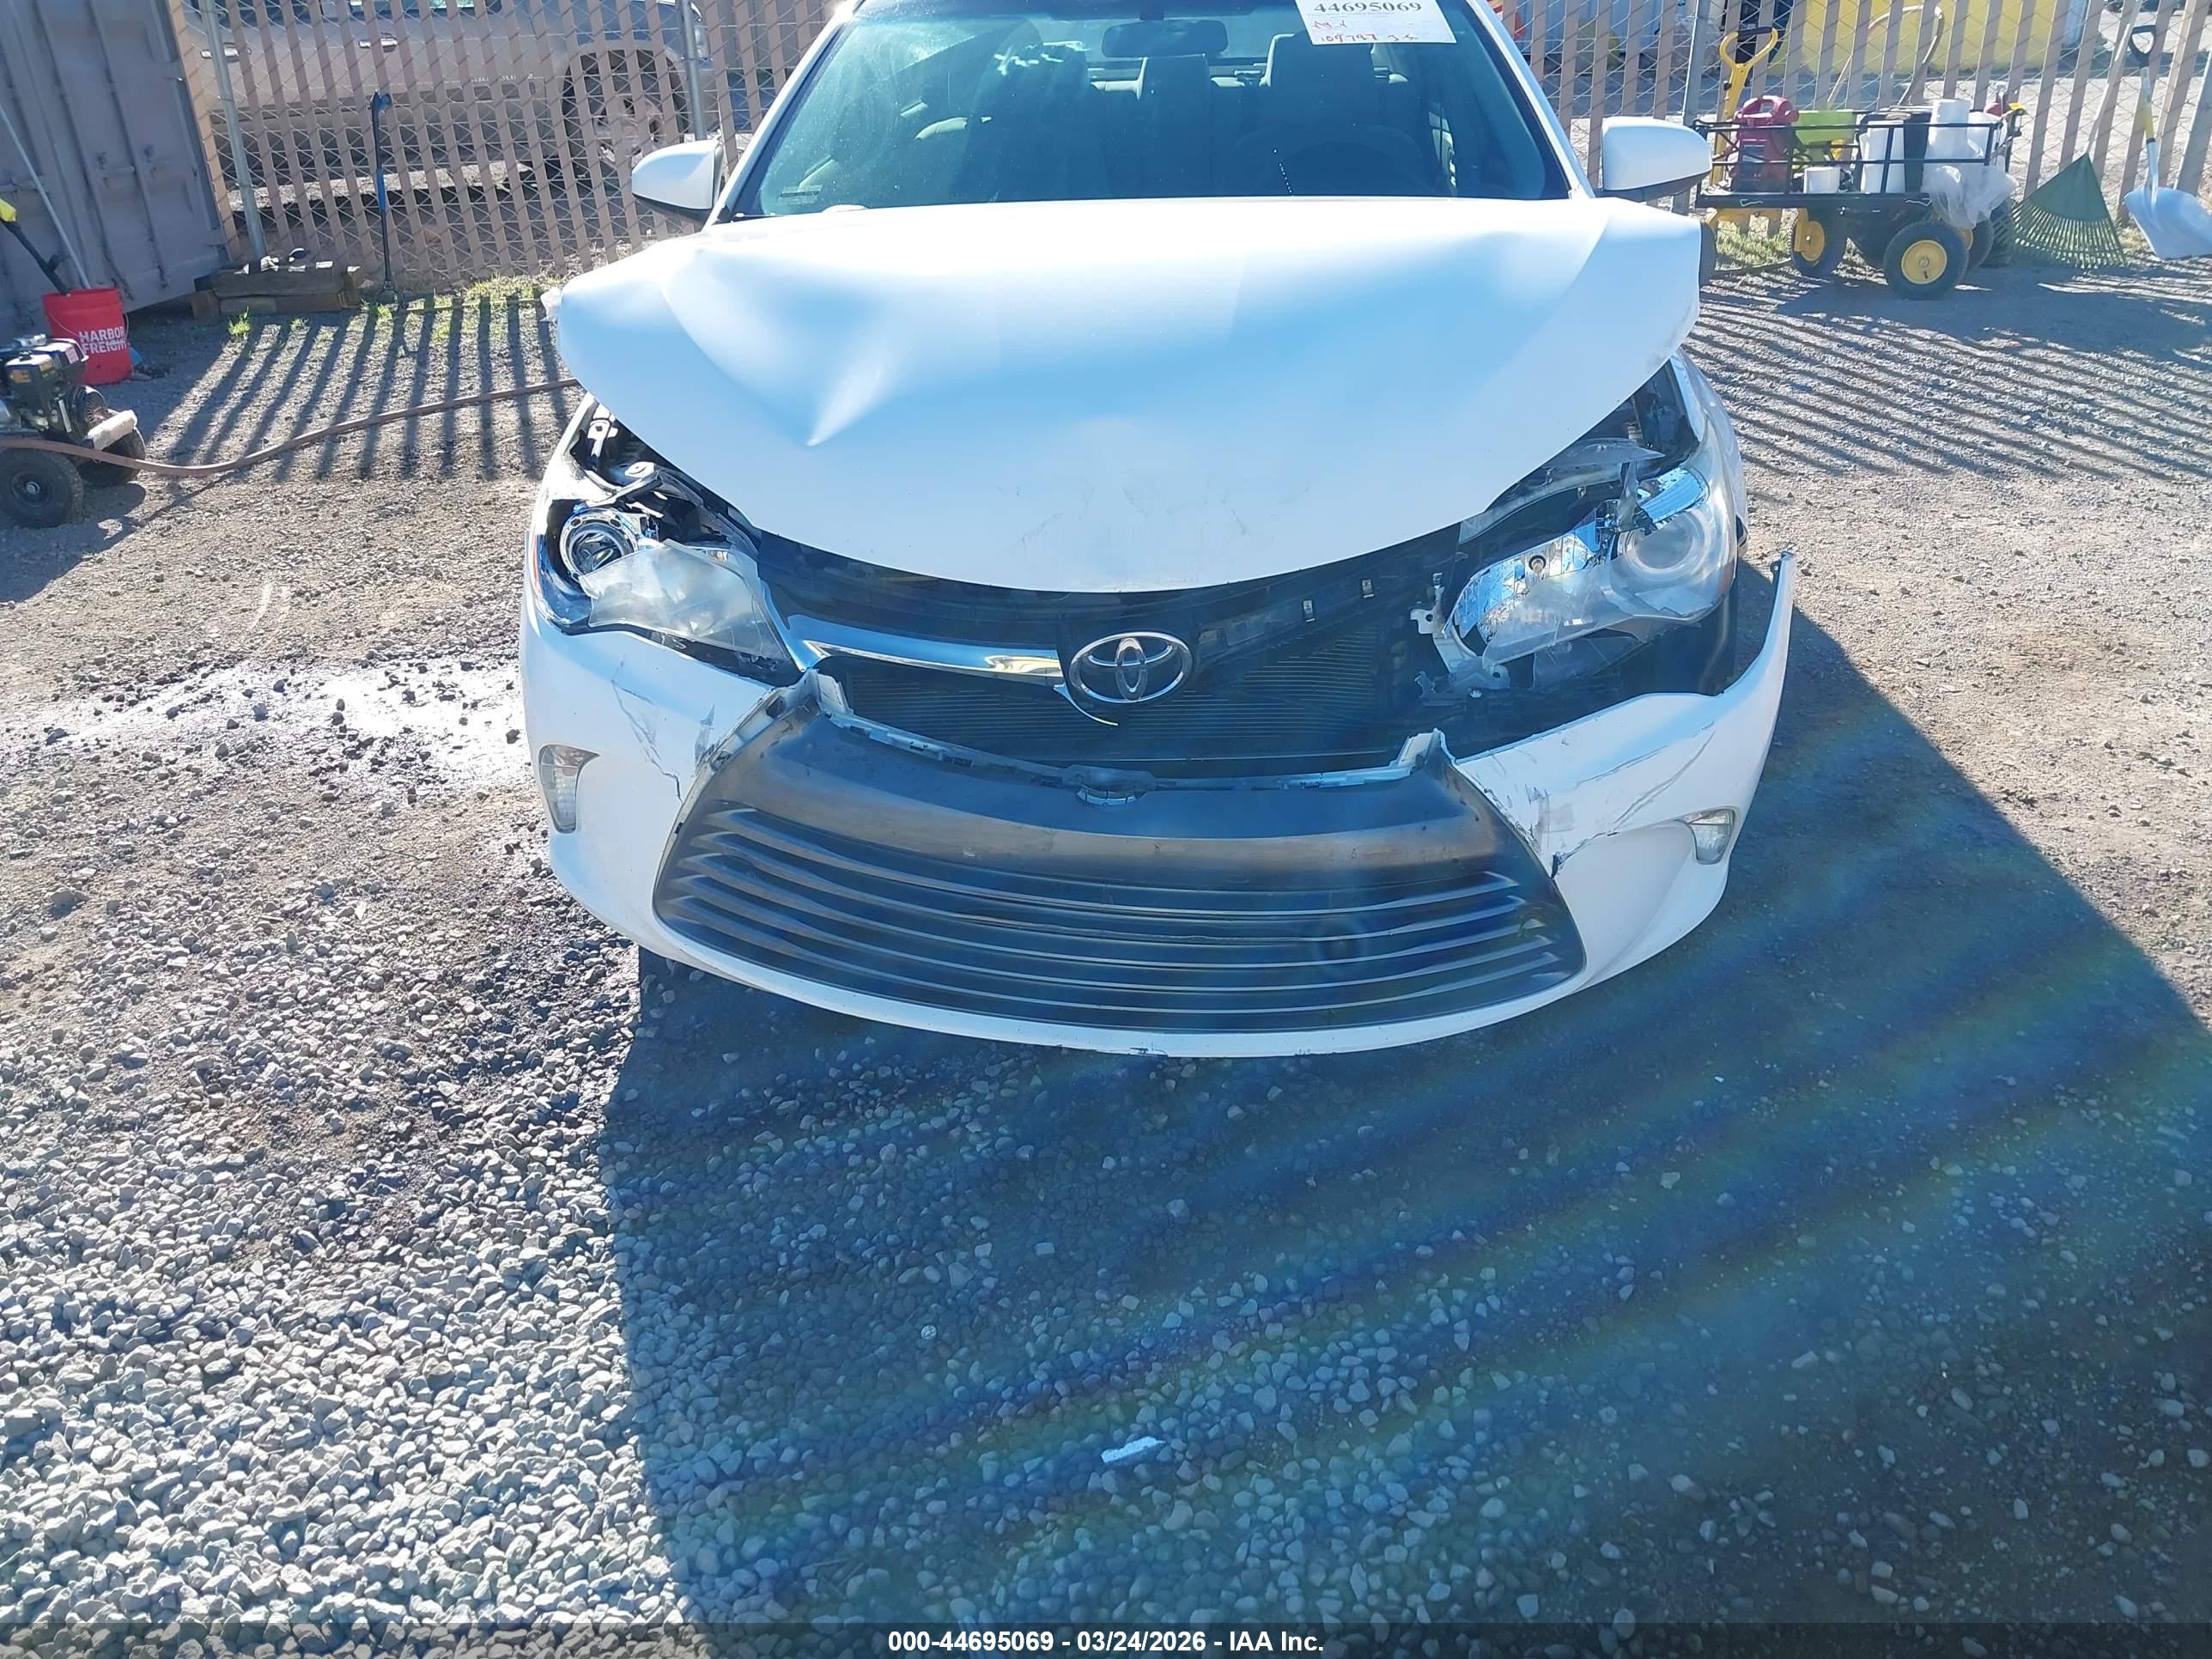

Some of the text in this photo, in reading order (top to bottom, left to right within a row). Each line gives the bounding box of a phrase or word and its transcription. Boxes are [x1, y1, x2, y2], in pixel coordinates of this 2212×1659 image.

[1313, 2, 1422, 13] 44695069
[79, 326, 125, 343] HARBOR
[81, 340, 127, 354] FREIGHT
